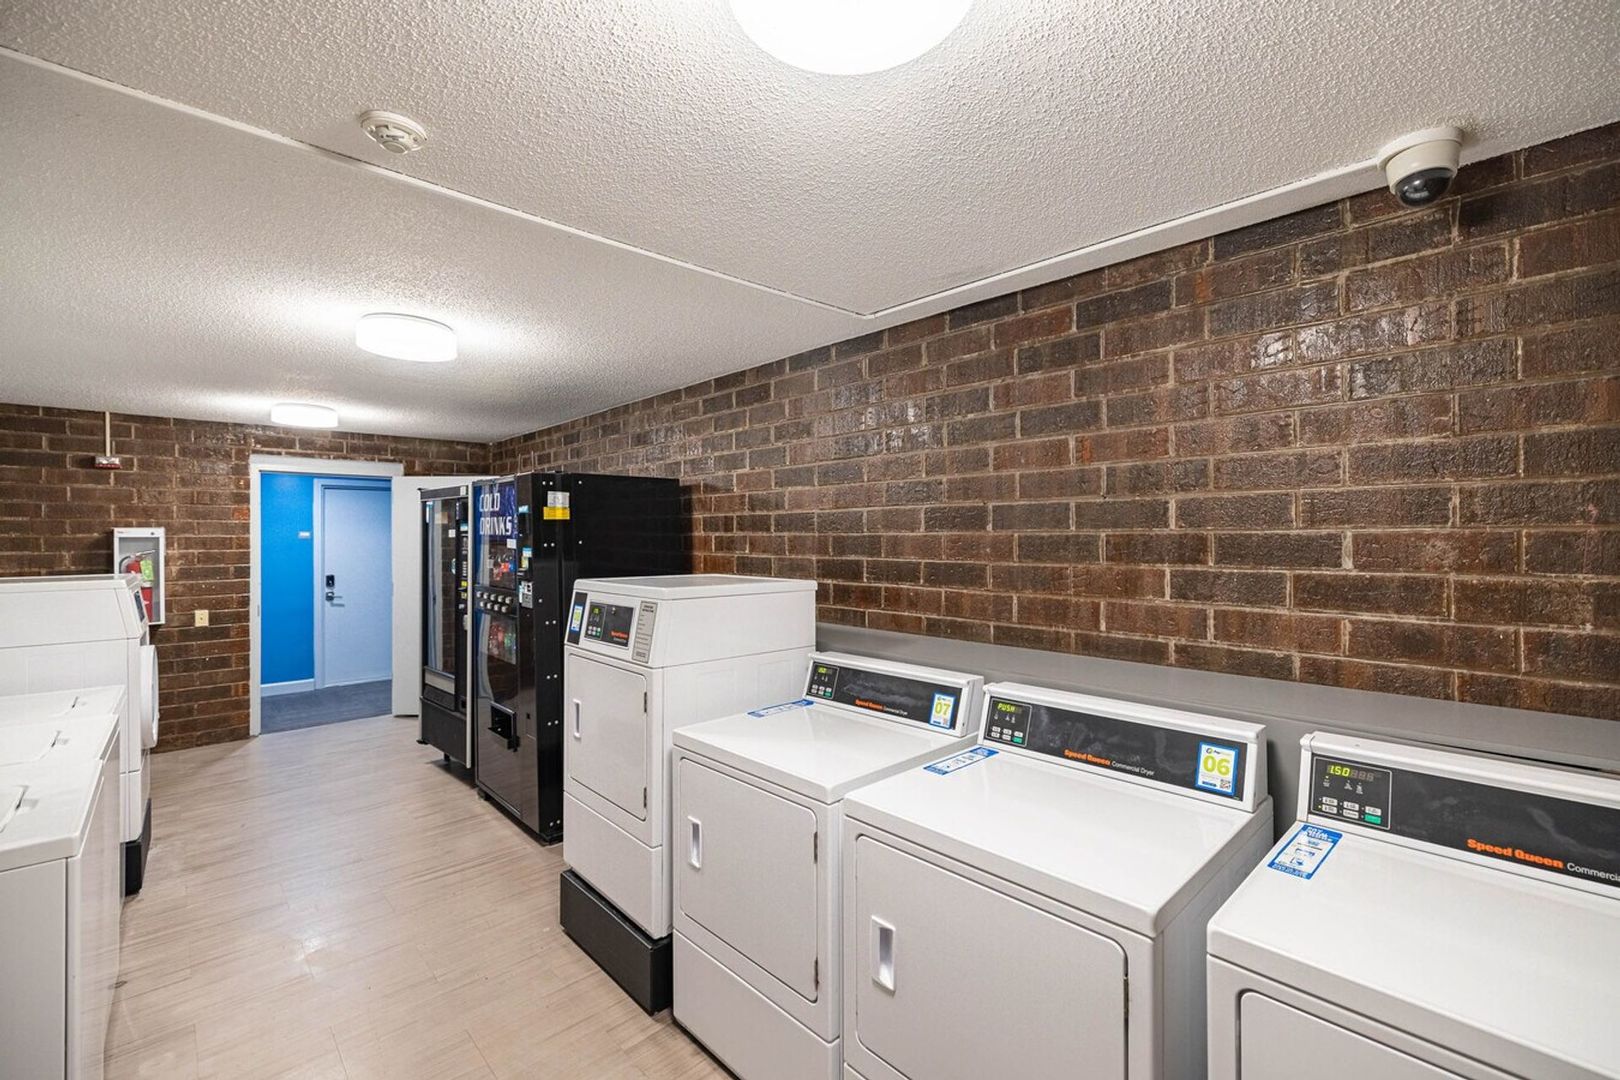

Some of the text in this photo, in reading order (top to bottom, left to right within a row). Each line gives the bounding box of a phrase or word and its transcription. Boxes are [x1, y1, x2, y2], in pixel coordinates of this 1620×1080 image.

[479, 493, 501, 512] COLD
[480, 516, 512, 535] DRINKS
[935, 701, 951, 716] 07
[997, 702, 1016, 713] PUSH
[1064, 749, 1087, 760] Speed
[1087, 754, 1111, 766] Queen
[1112, 761, 1140, 773] Commercial
[1203, 755, 1230, 776] 06
[1467, 838, 1513, 857] Speed
[1514, 849, 1564, 869] Queen
